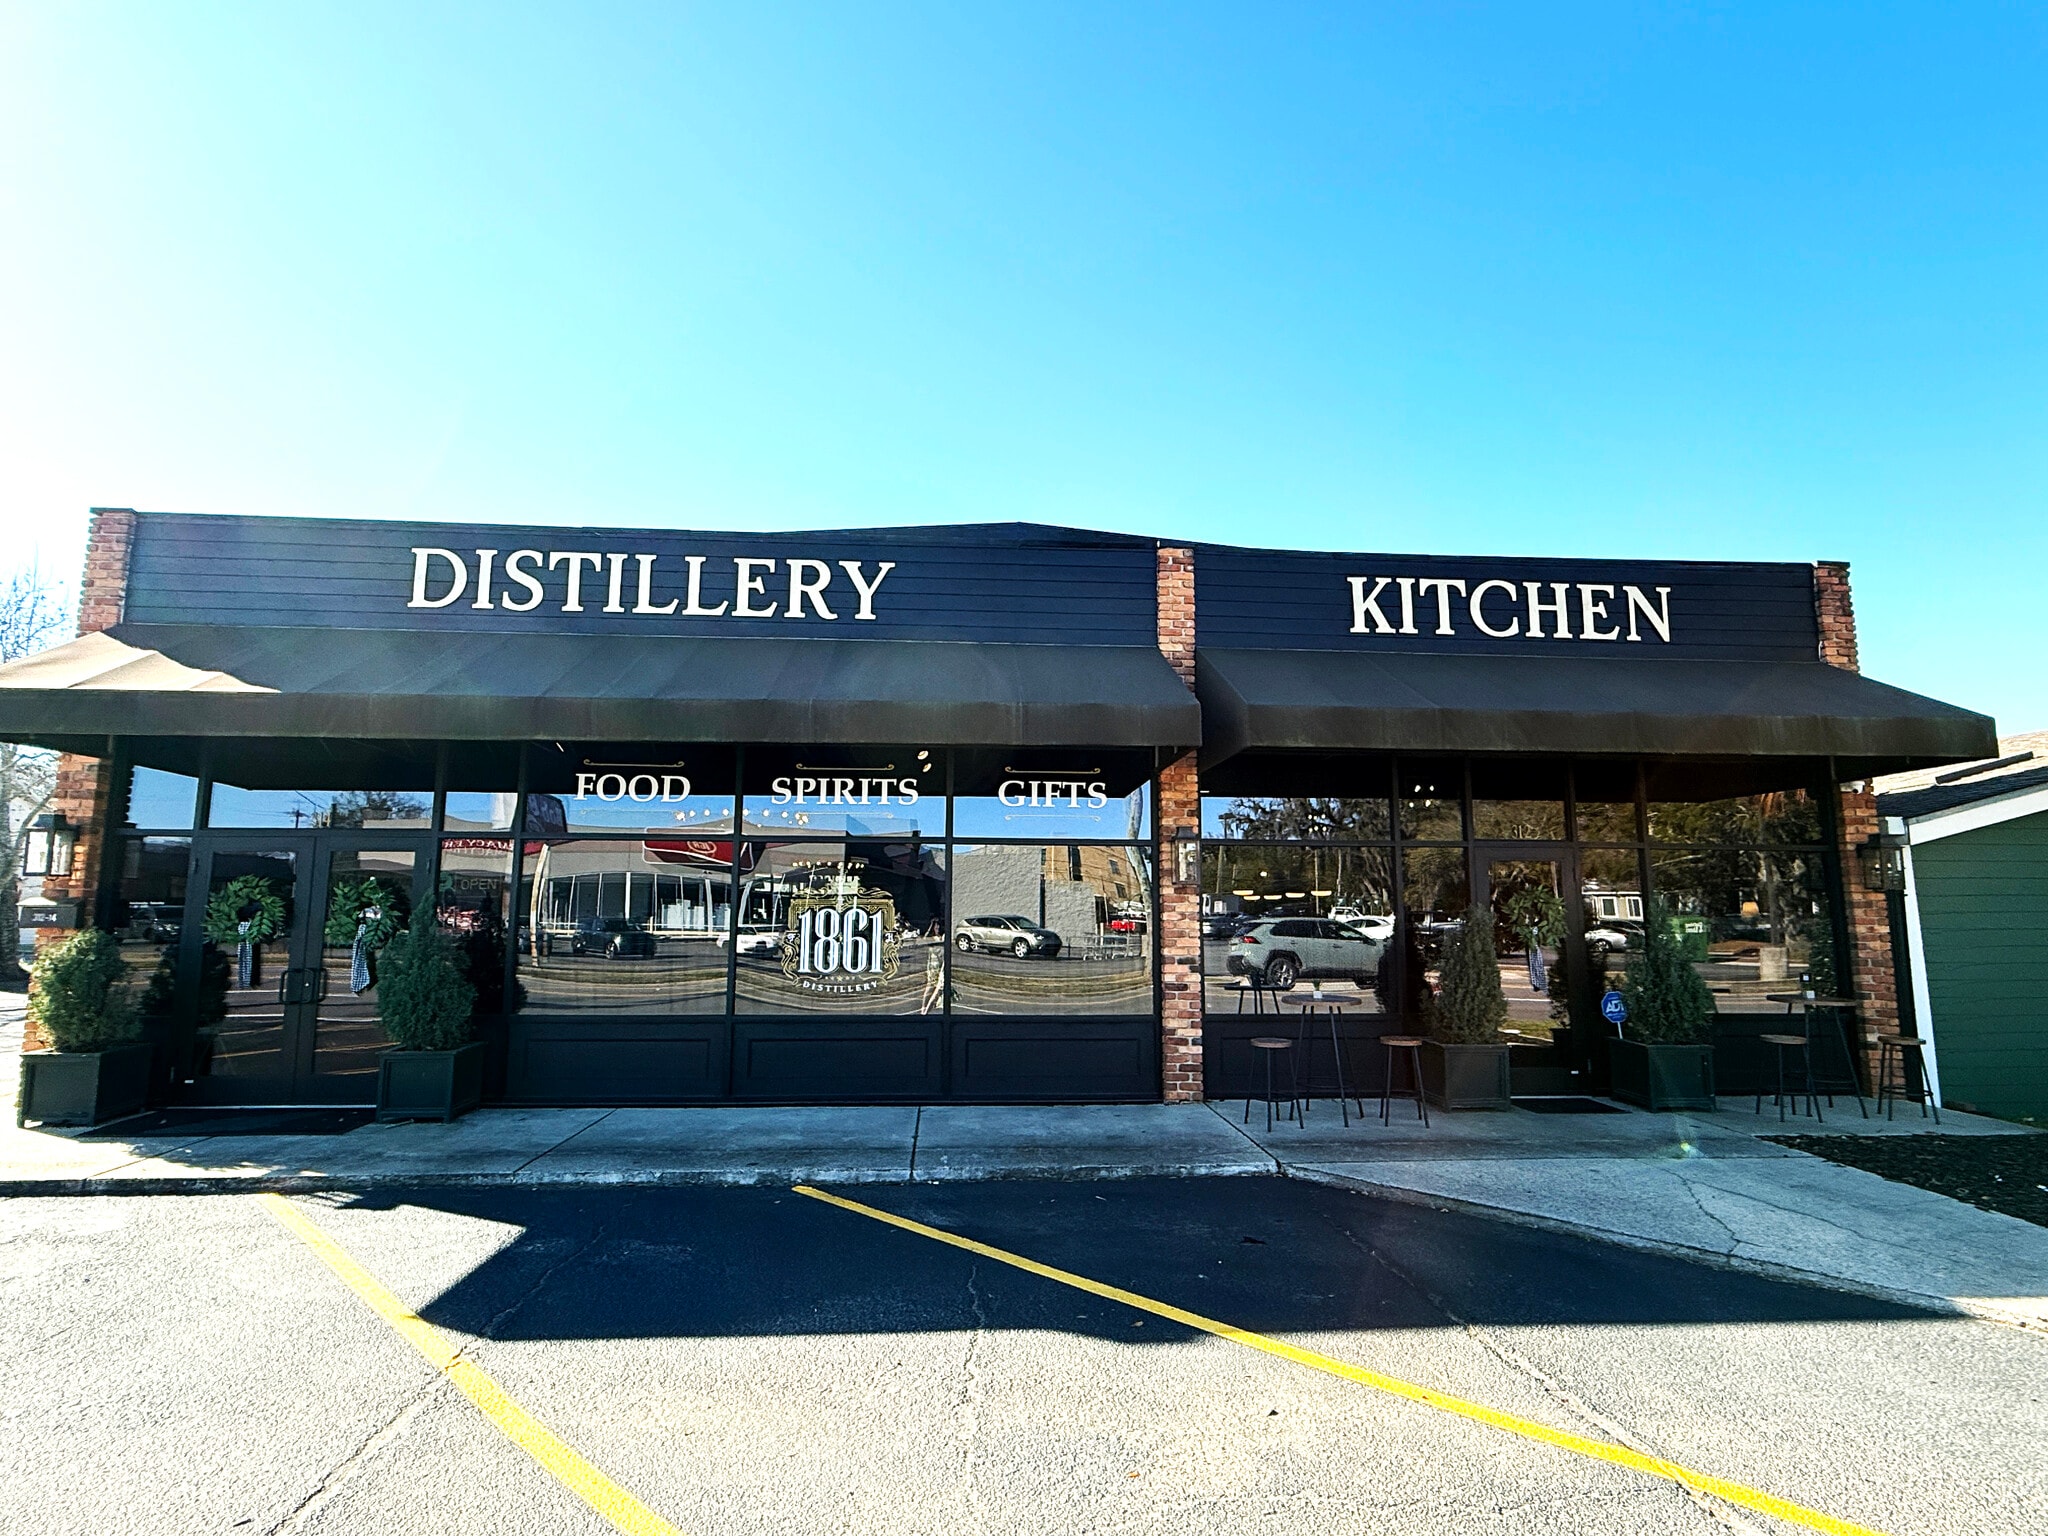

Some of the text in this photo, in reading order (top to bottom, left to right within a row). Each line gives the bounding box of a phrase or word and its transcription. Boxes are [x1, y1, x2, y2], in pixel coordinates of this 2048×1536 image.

[406, 547, 896, 621] DISTILLERY
[1346, 576, 1672, 643] KITCHEN
[573, 773, 692, 803] FOOD
[771, 777, 920, 806] SPIRITS
[997, 779, 1108, 809] GIFTS
[461, 879, 497, 891] OPEN
[798, 908, 883, 973] 1861
[802, 980, 878, 993] DISTILLERY
